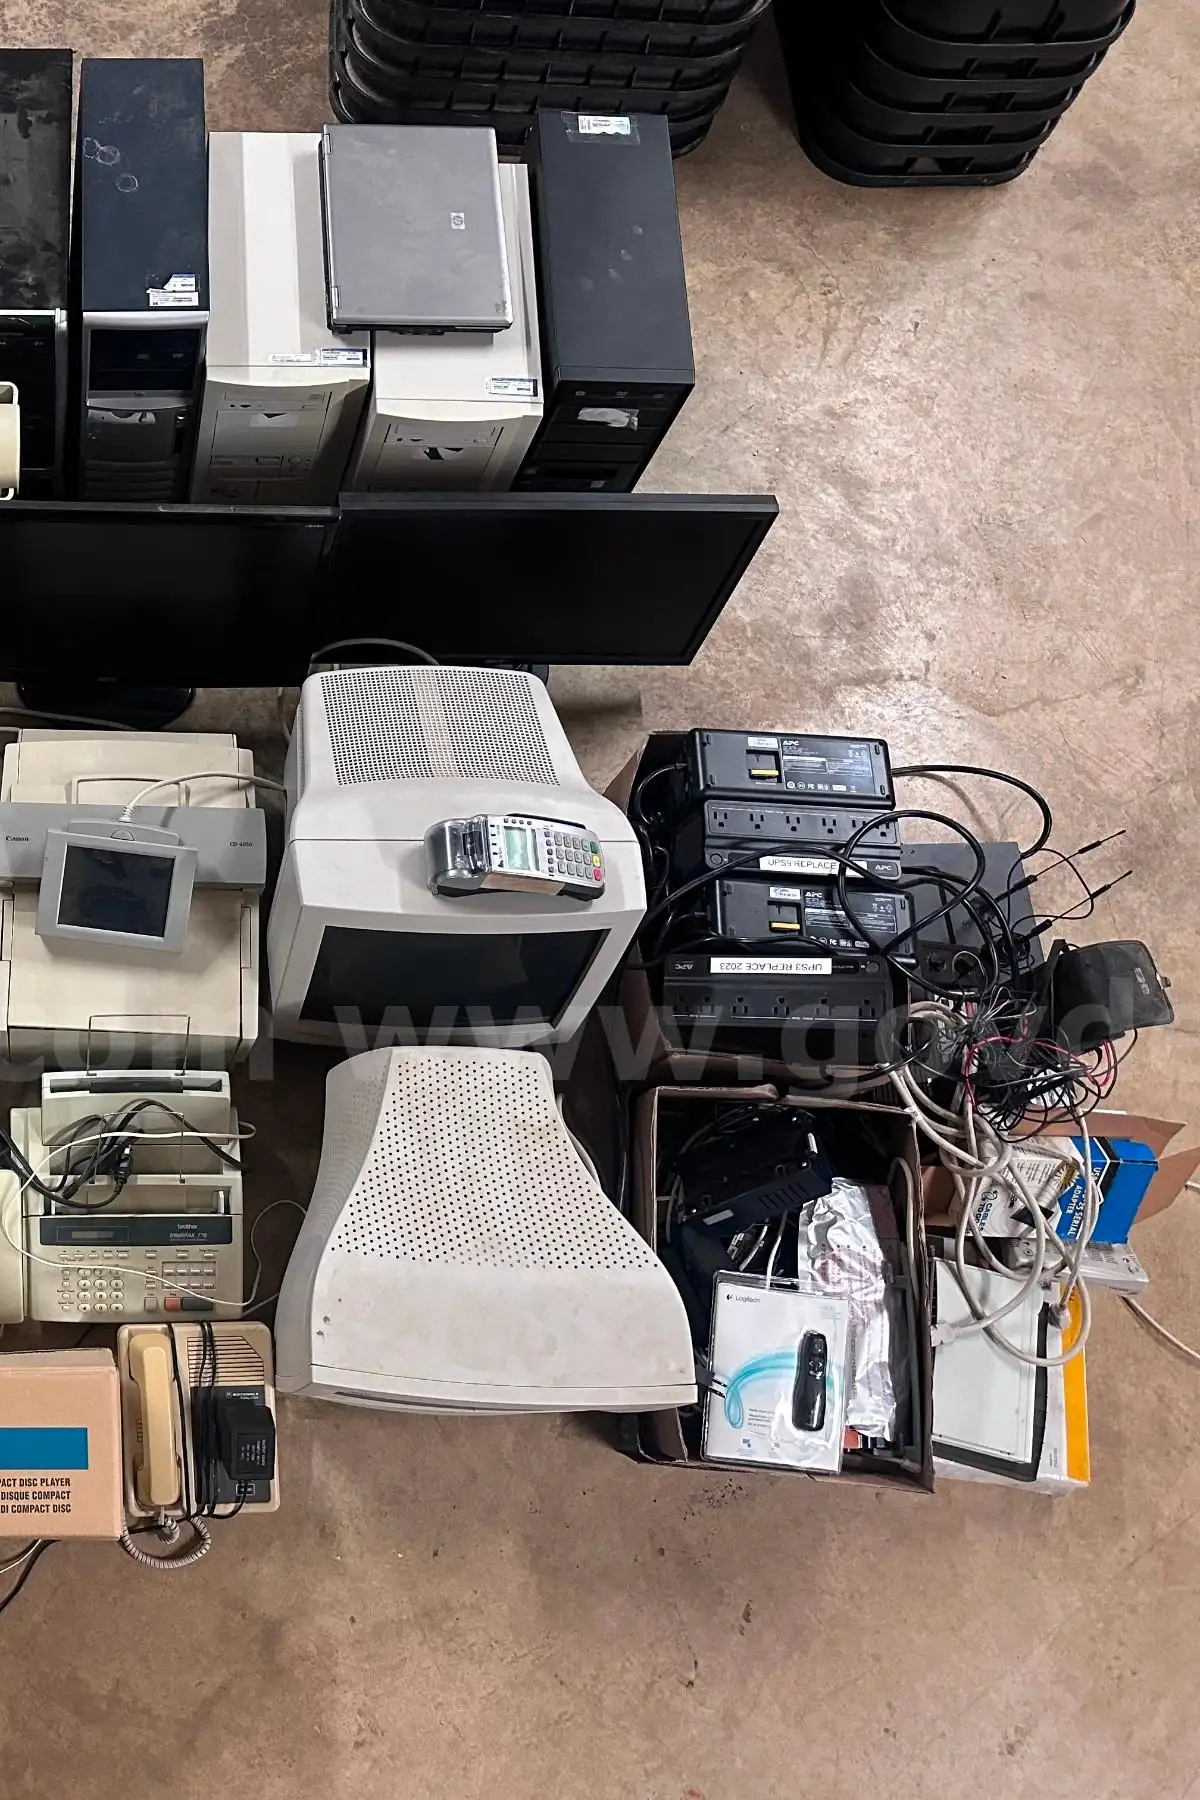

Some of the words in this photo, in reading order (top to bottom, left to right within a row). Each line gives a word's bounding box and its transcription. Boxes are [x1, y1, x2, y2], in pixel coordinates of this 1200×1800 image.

[767, 859, 792, 867] UPS9
[794, 859, 837, 870] REPLACE
[719, 962, 743, 971] 2023
[745, 962, 793, 971] REPLACE
[795, 963, 823, 972] UPS3
[1066, 1186, 1082, 1214] ADAPTER
[1068, 1211, 1082, 1236] SERIAL
[735, 1294, 761, 1303] Logitech
[19, 1478, 38, 1487] DISC
[40, 1477, 71, 1487] PLAYER
[0, 1491, 30, 1502] DISQUE
[32, 1490, 71, 1500] COMPACT
[0, 1504, 9, 1514] DI
[11, 1504, 50, 1514] COMPACT
[52, 1503, 72, 1513] DISC
